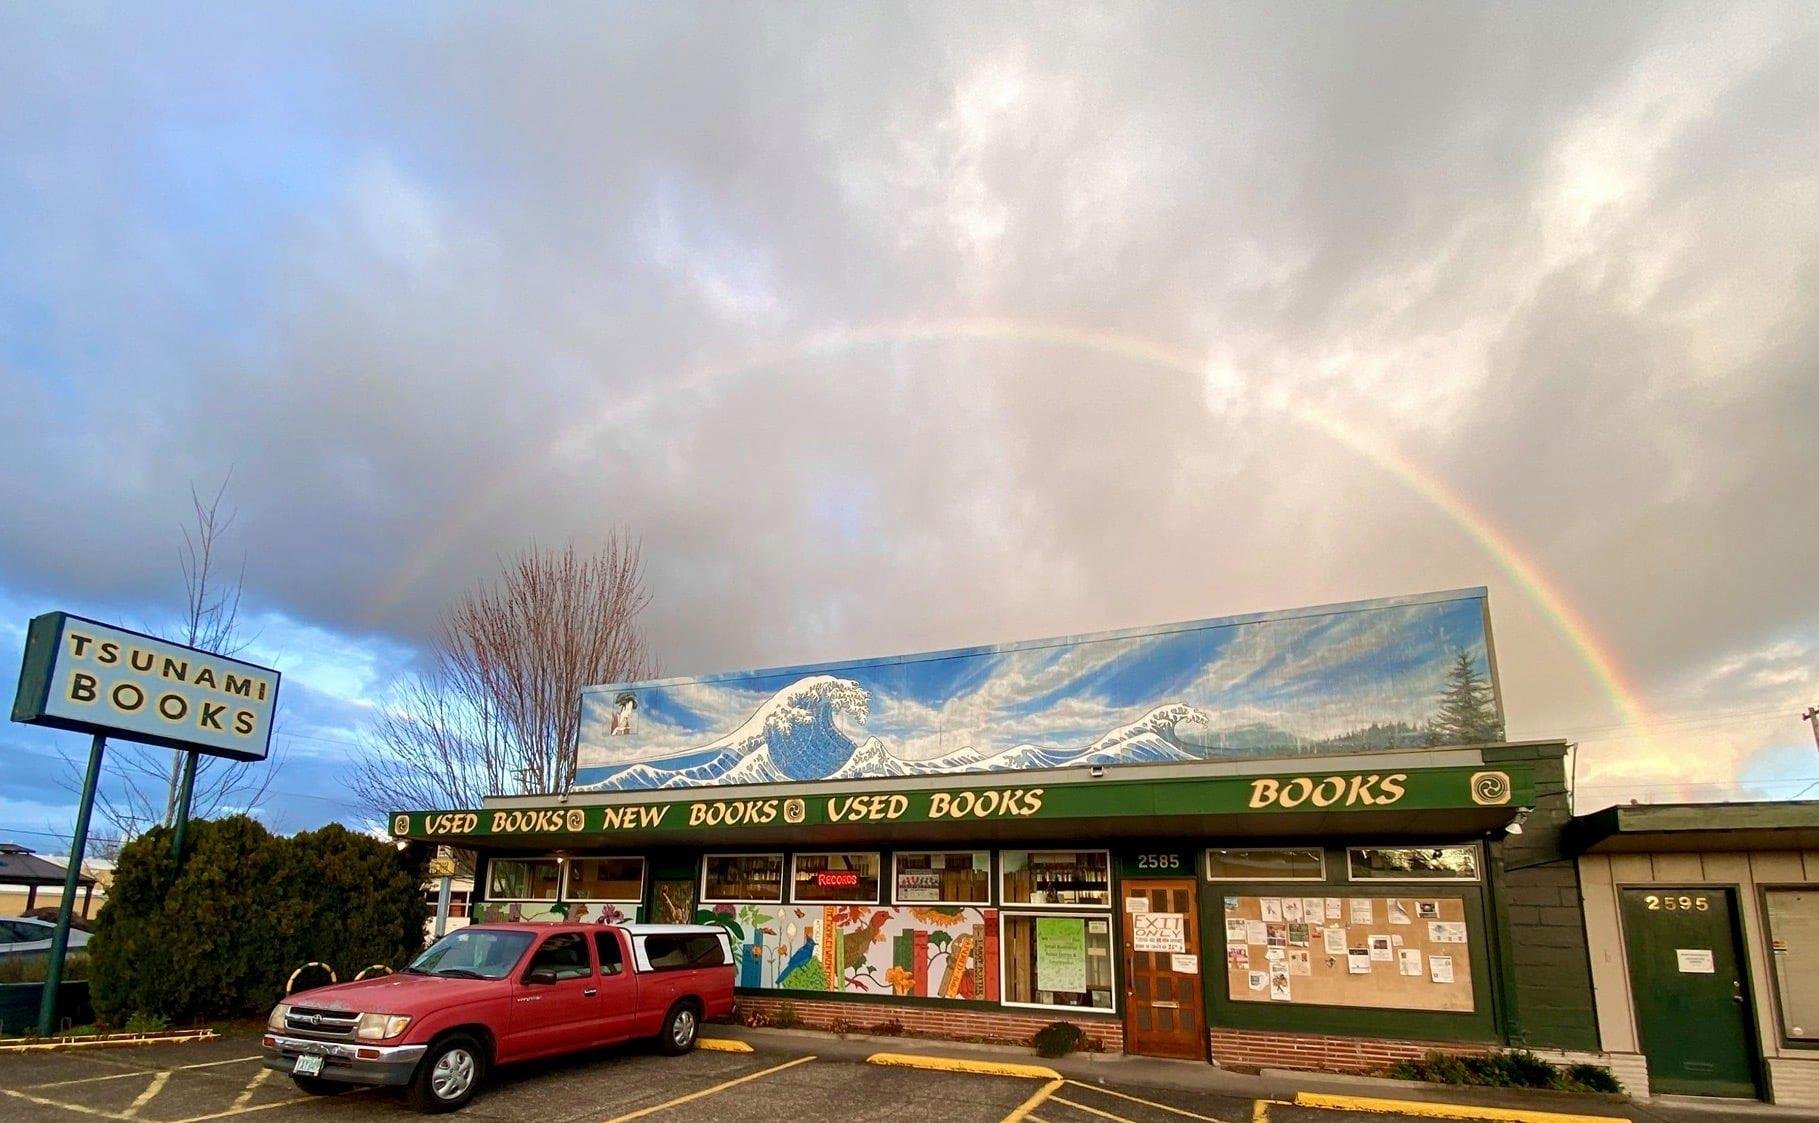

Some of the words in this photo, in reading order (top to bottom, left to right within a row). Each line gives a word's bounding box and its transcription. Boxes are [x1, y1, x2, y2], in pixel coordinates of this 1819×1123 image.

[71, 634, 266, 701] TSUNAMI
[70, 673, 254, 735] BOOKS
[1248, 774, 1407, 808] BOOKS
[603, 805, 668, 830] NEW
[689, 799, 778, 826] BOOKS
[827, 794, 908, 822] USED
[929, 789, 1044, 818] BOOKS
[425, 813, 477, 835] USED
[491, 810, 564, 832] BOOKS
[1138, 854, 1179, 868] 2585
[1645, 895, 1709, 912] 2595
[1135, 914, 1182, 929] EXIT
[1136, 929, 1181, 938] ONLY
